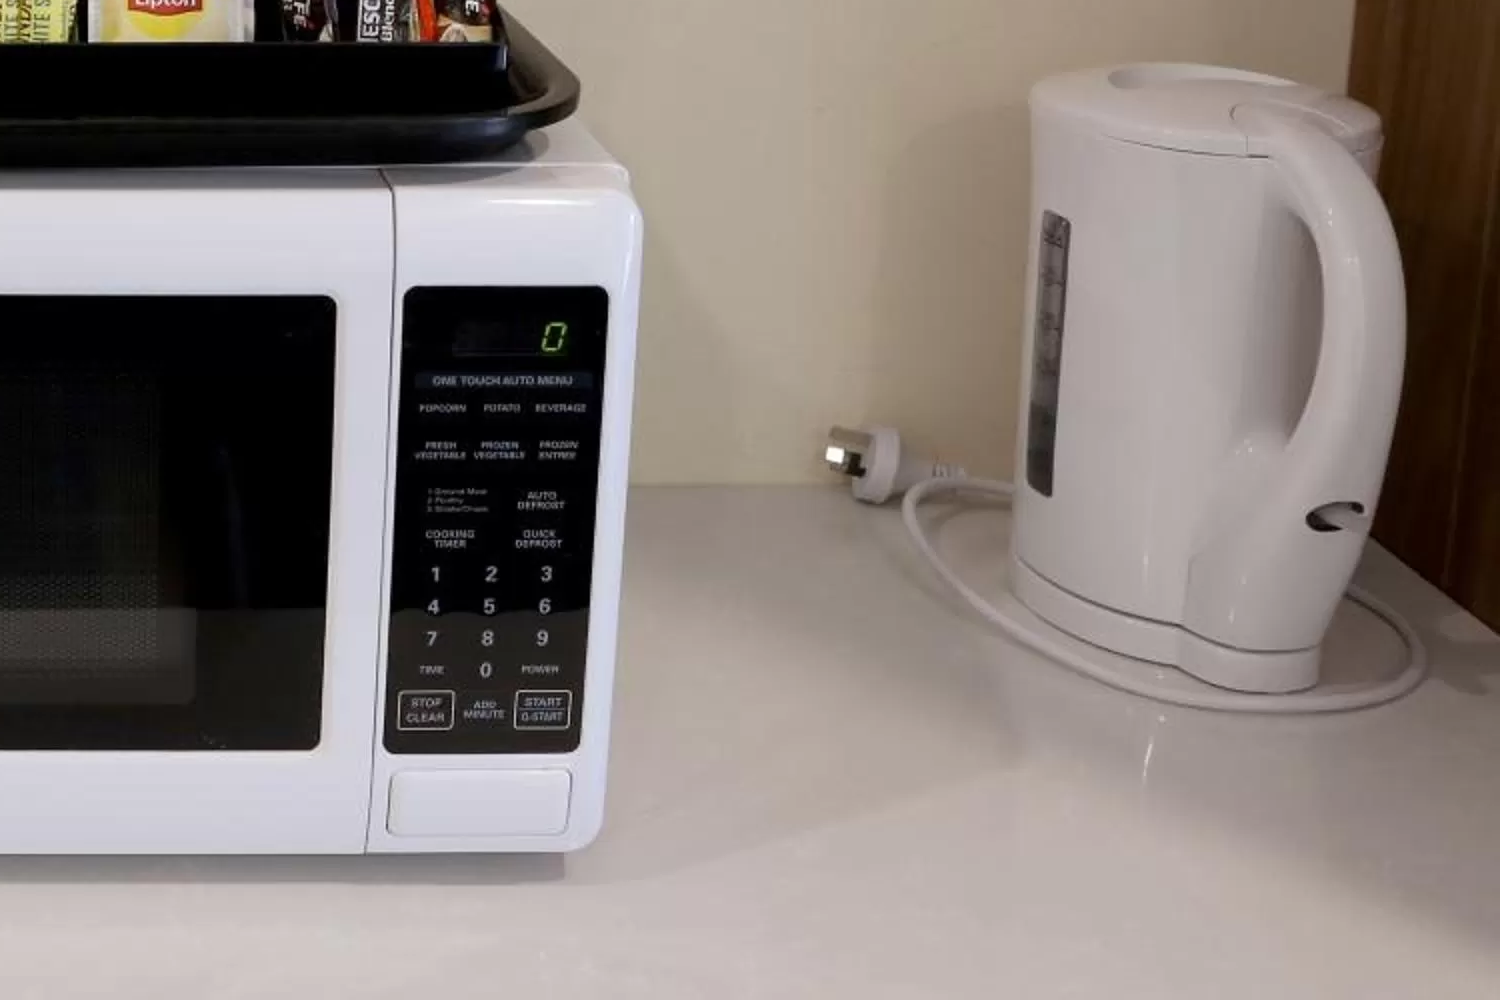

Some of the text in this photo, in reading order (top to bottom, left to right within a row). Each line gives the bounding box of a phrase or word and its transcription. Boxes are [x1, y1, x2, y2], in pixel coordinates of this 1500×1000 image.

[541, 321, 569, 351] 0
[433, 375, 573, 386] ONE TOUCH AUTO MENU
[419, 403, 467, 413] POPCORN
[483, 403, 521, 413] POTATO
[535, 403, 587, 413] BEVERAGE
[425, 441, 457, 450] FRESH
[480, 441, 519, 450] FROZEN
[539, 440, 579, 449] FROZEN
[414, 451, 466, 460] VEGETABLE
[473, 451, 525, 460] VEGETABLE
[527, 491, 557, 500] AUTO
[517, 501, 565, 510] DEFROST
[425, 529, 475, 539] COOKING
[523, 529, 556, 539] QUICK
[434, 539, 467, 549] TIMER
[515, 539, 563, 549] DEFROST
[431, 566, 440, 582] 1
[485, 566, 498, 582] 2
[541, 566, 552, 582] 3
[427, 599, 439, 615] 4
[484, 599, 495, 615] 5
[539, 599, 551, 615] 6
[427, 631, 437, 646] 7
[481, 631, 494, 646] 8
[536, 631, 549, 646] 9
[419, 665, 445, 674] TIME
[479, 662, 492, 678] 0
[521, 664, 559, 674] POWER
[411, 698, 442, 709] STOP
[473, 701, 497, 709] ADD
[523, 698, 562, 708] START
[406, 712, 445, 723] CLEAR
[464, 710, 505, 720] MINUTE
